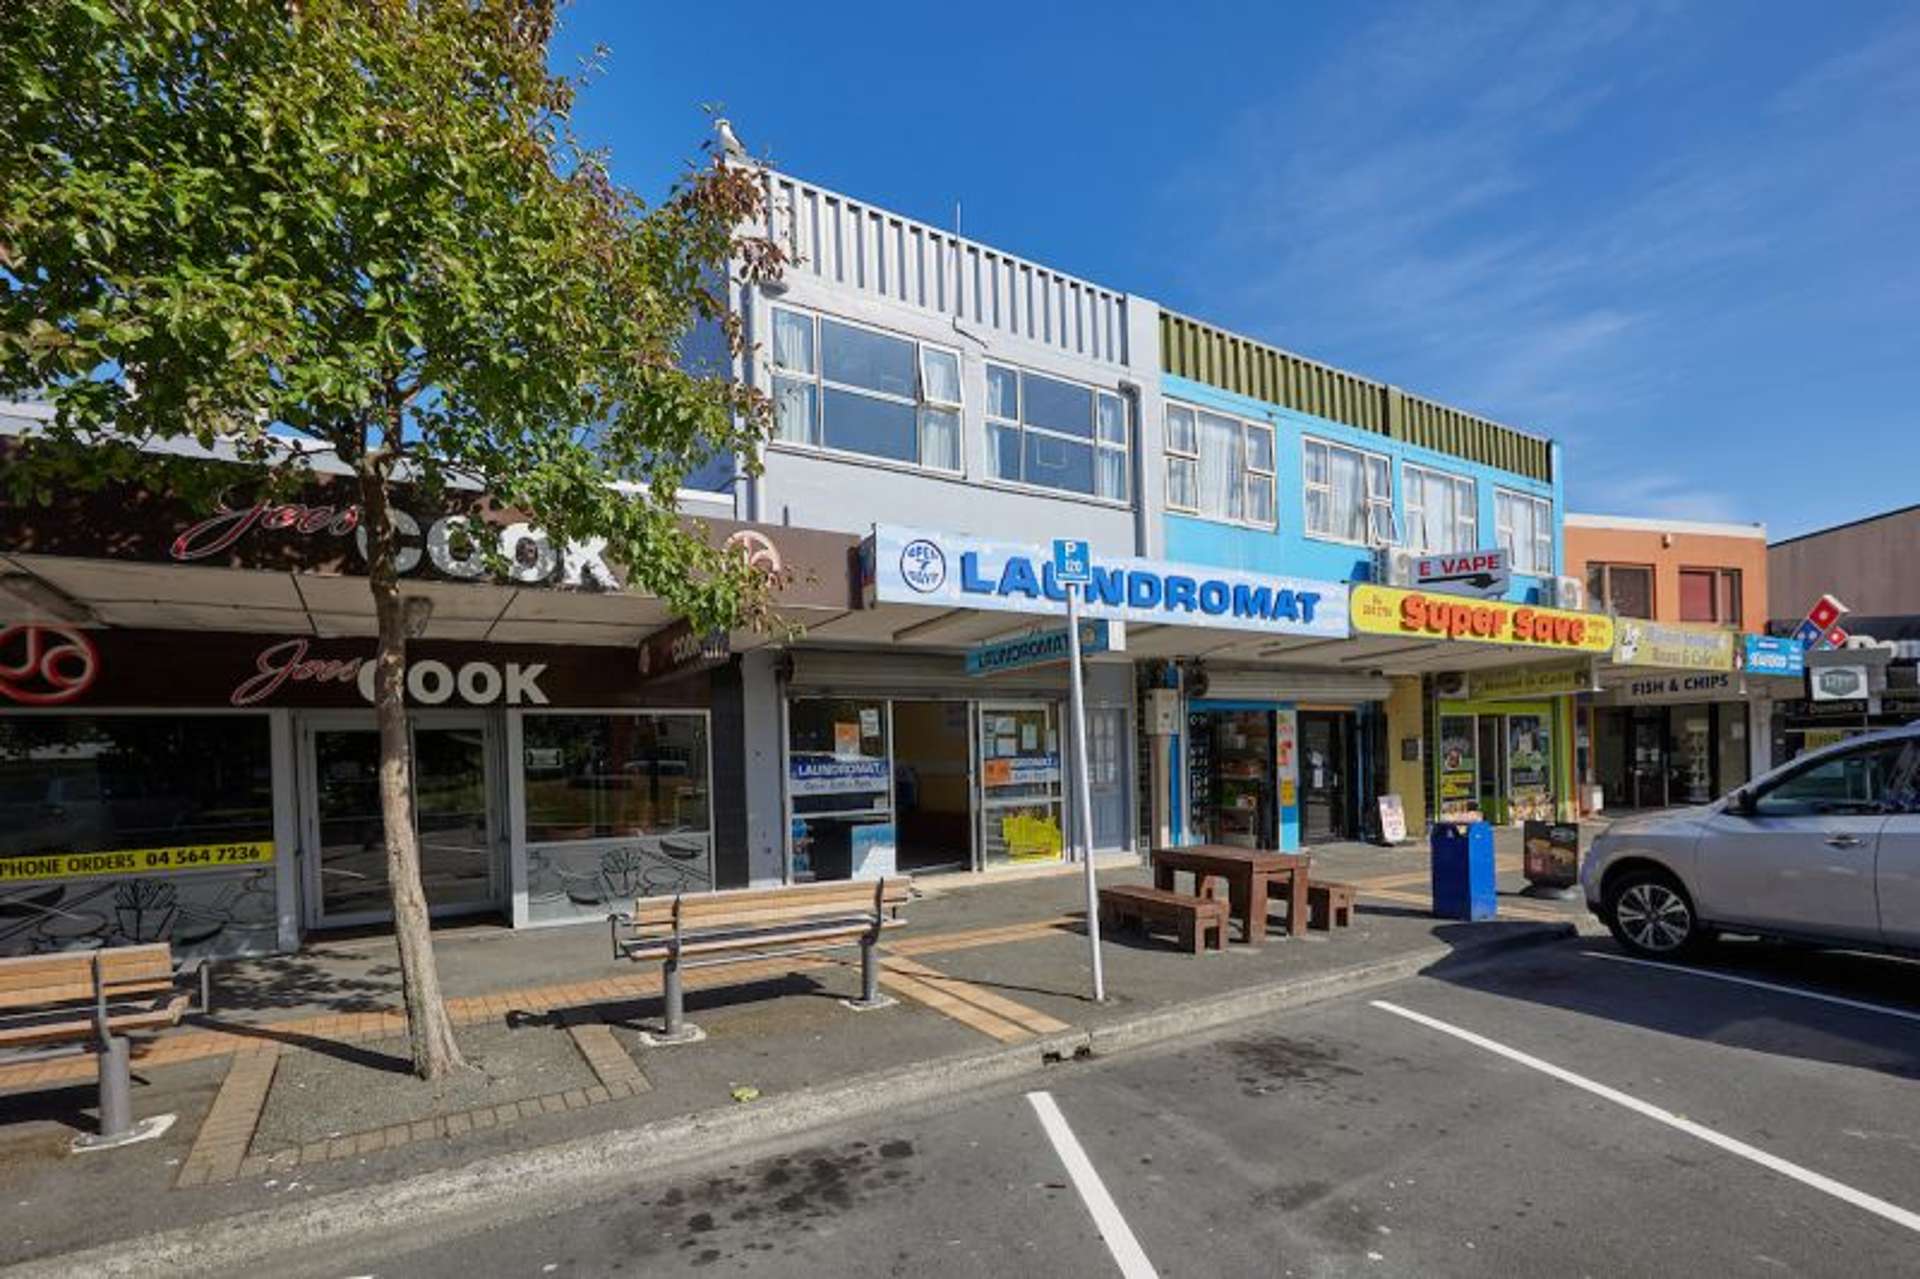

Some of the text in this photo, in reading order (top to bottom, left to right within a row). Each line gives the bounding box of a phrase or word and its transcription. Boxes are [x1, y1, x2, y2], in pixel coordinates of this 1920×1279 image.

[1065, 541, 1077, 557] P
[1419, 554, 1500, 576] E VAPE
[960, 551, 1320, 624] LAUNDROMAT
[1400, 594, 1508, 642] Super
[1511, 608, 1585, 645] Save
[1632, 674, 1729, 695] FISH & CHIPS
[798, 763, 881, 777] LAUNDROMAT
[0, 847, 260, 876] PHONE ORDERS 04 564 7236
